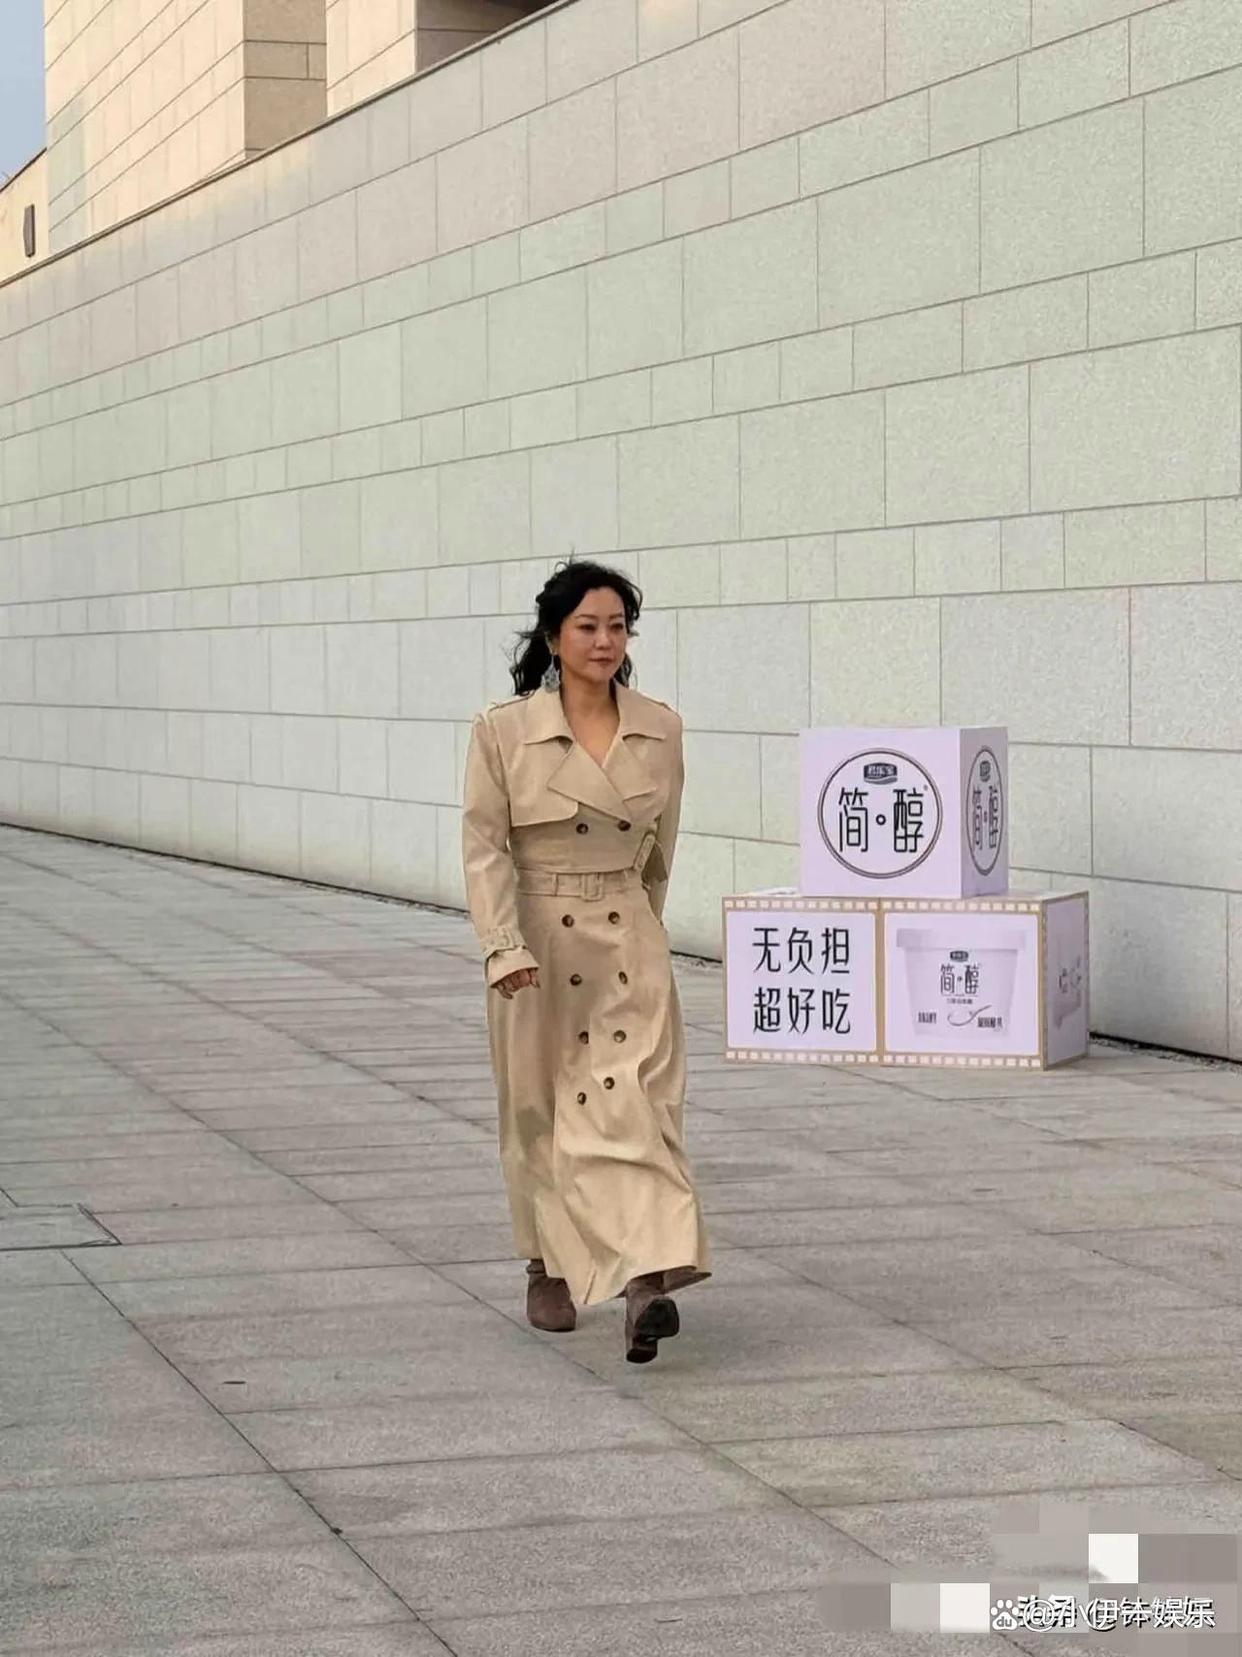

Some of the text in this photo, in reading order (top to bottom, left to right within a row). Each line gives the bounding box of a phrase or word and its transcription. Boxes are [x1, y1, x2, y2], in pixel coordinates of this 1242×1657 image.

[752, 927, 850, 975] 无负担
[753, 986, 851, 1035] 超好吃
